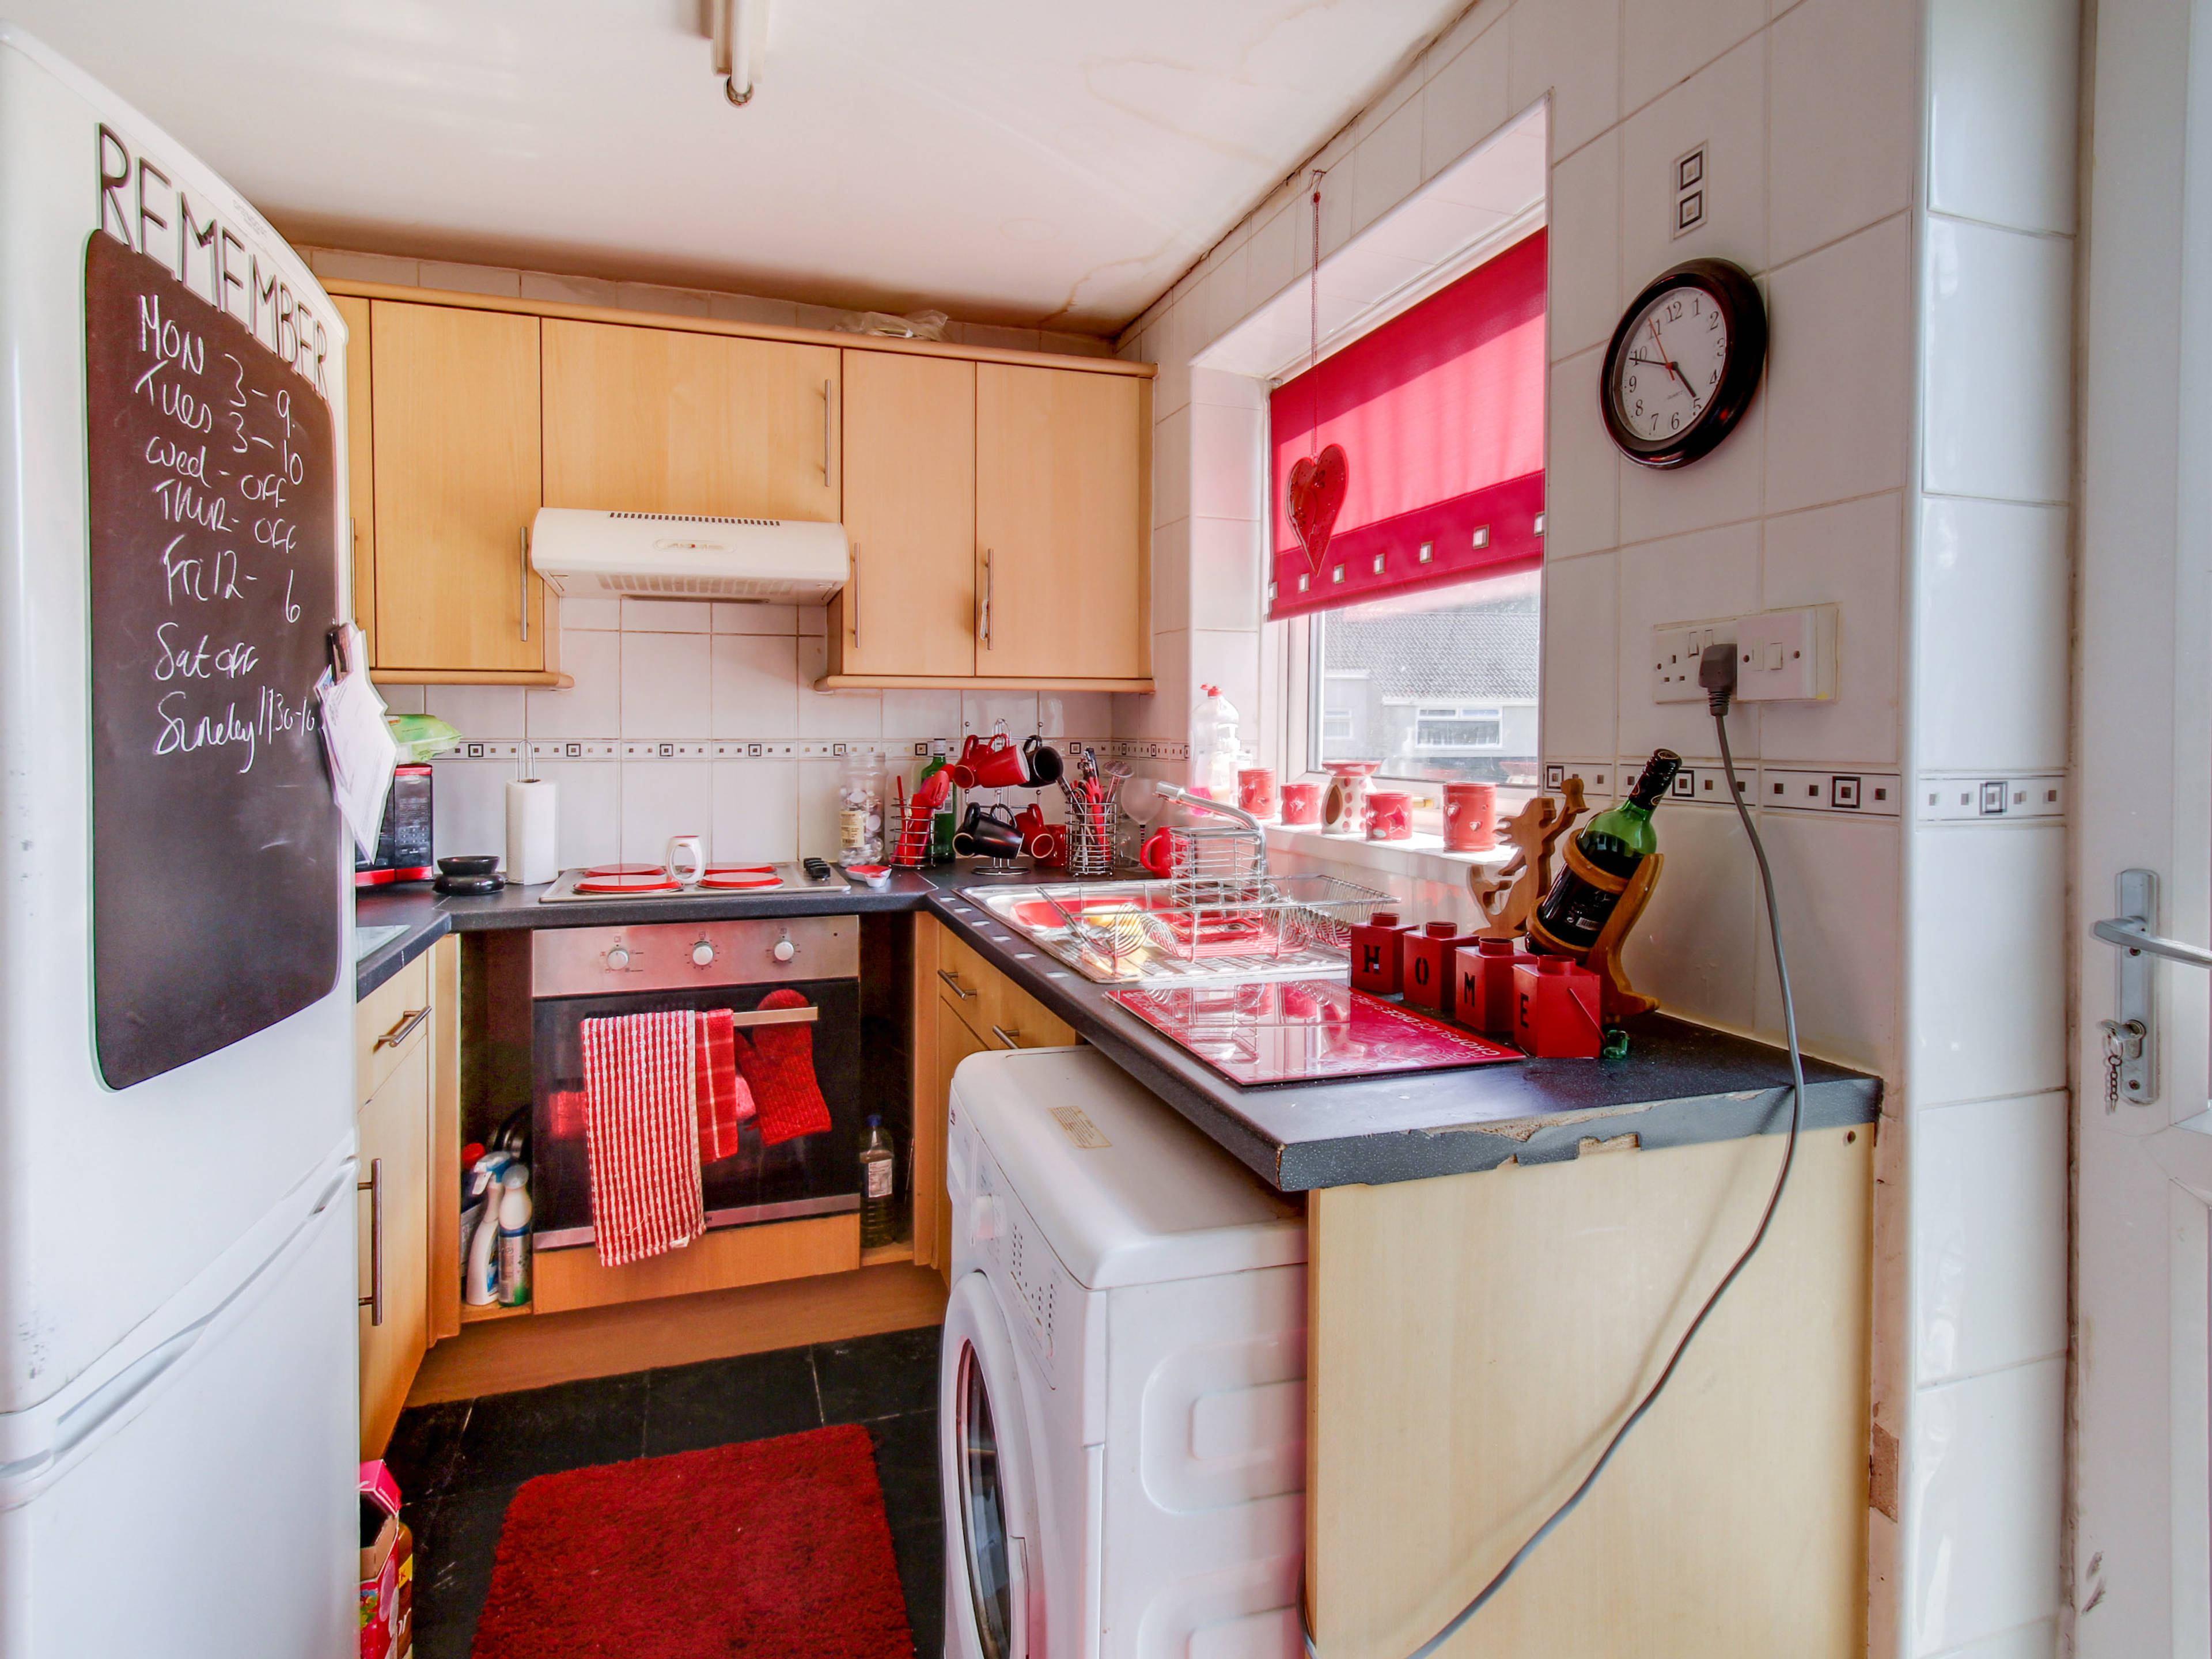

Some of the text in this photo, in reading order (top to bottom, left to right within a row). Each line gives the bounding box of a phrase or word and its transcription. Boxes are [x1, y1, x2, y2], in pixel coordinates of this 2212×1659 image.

[98, 122, 327, 401] REMEMBER
[1665, 300, 1683, 323] 12
[1693, 298, 1702, 316] 1
[1648, 318, 1663, 340] 11
[1709, 310, 1719, 331] 2
[138, 294, 204, 376] MON
[1632, 345, 1648, 366] 10
[1716, 337, 1725, 357] 3
[1628, 375, 1638, 393] 9
[1709, 369, 1718, 385] 4
[134, 359, 213, 434] Tues
[1692, 397, 1702, 412] 5
[1635, 399, 1644, 417] 8
[1650, 413, 1660, 432] 7
[1671, 411, 1680, 430] 6
[160, 533, 209, 606] Fri
[154, 622, 211, 681] Sat
[1381, 1009, 1421, 1023] DICE
[1410, 1021, 1459, 1039] SLICE
[1449, 1037, 1501, 1056] CHOP
